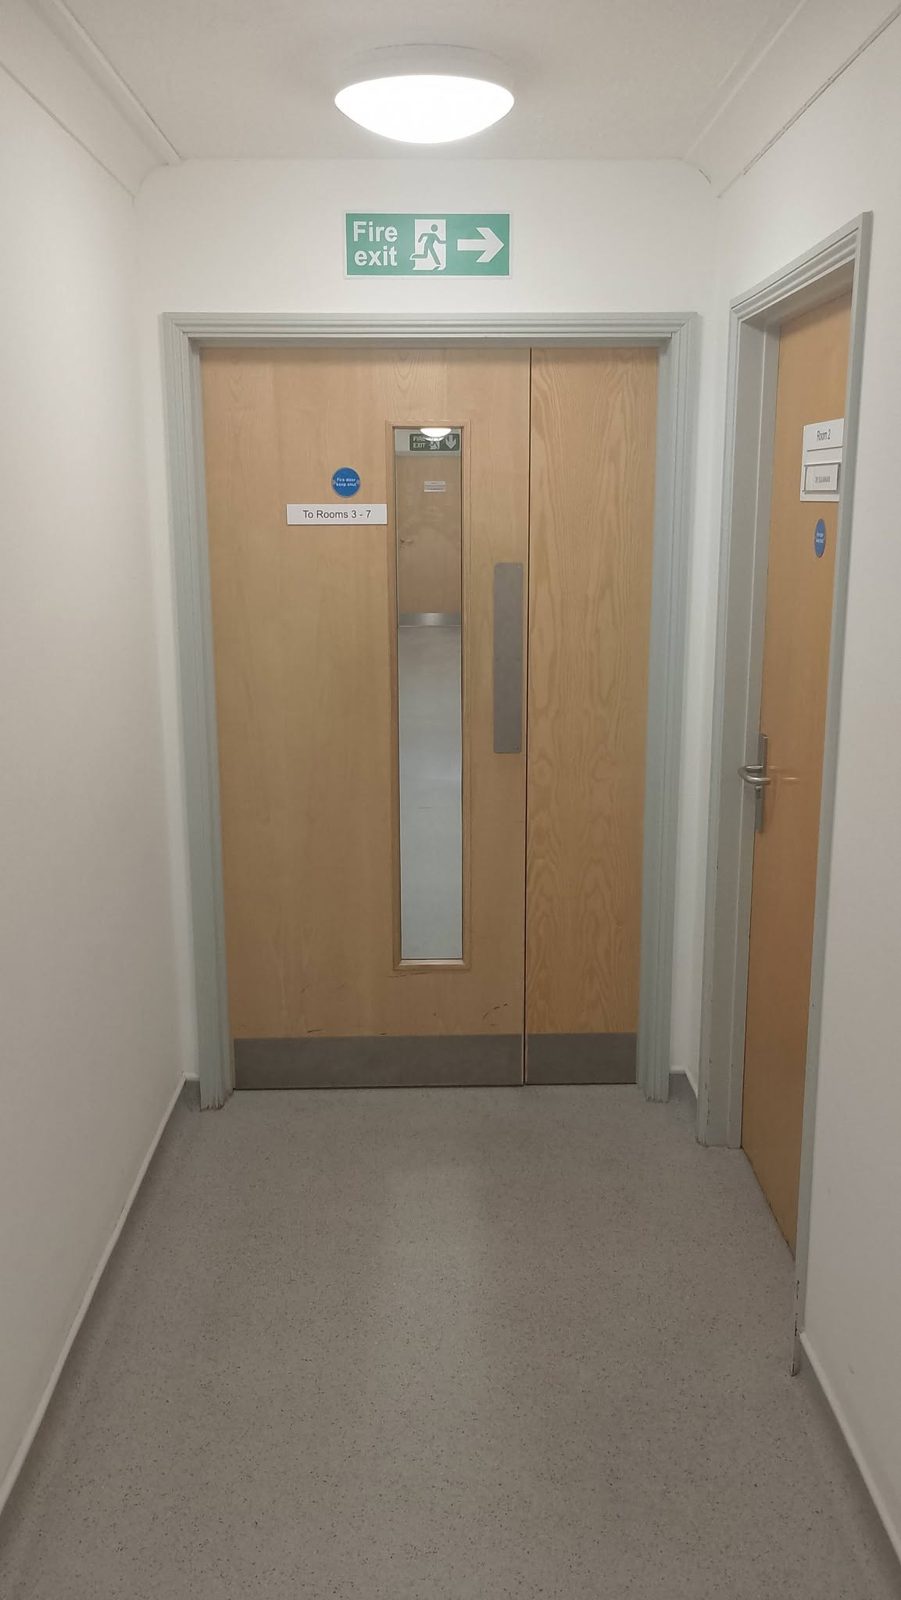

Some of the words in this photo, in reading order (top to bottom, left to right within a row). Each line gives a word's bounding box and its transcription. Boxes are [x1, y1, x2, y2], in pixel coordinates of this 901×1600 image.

[353, 220, 398, 242] Fire
[354, 245, 398, 266] exit
[816, 430, 828, 441] Room
[827, 428, 832, 440] 2
[302, 509, 314, 519] To
[316, 509, 349, 519] Rooms
[351, 509, 357, 519] 3
[365, 509, 372, 519] 7
